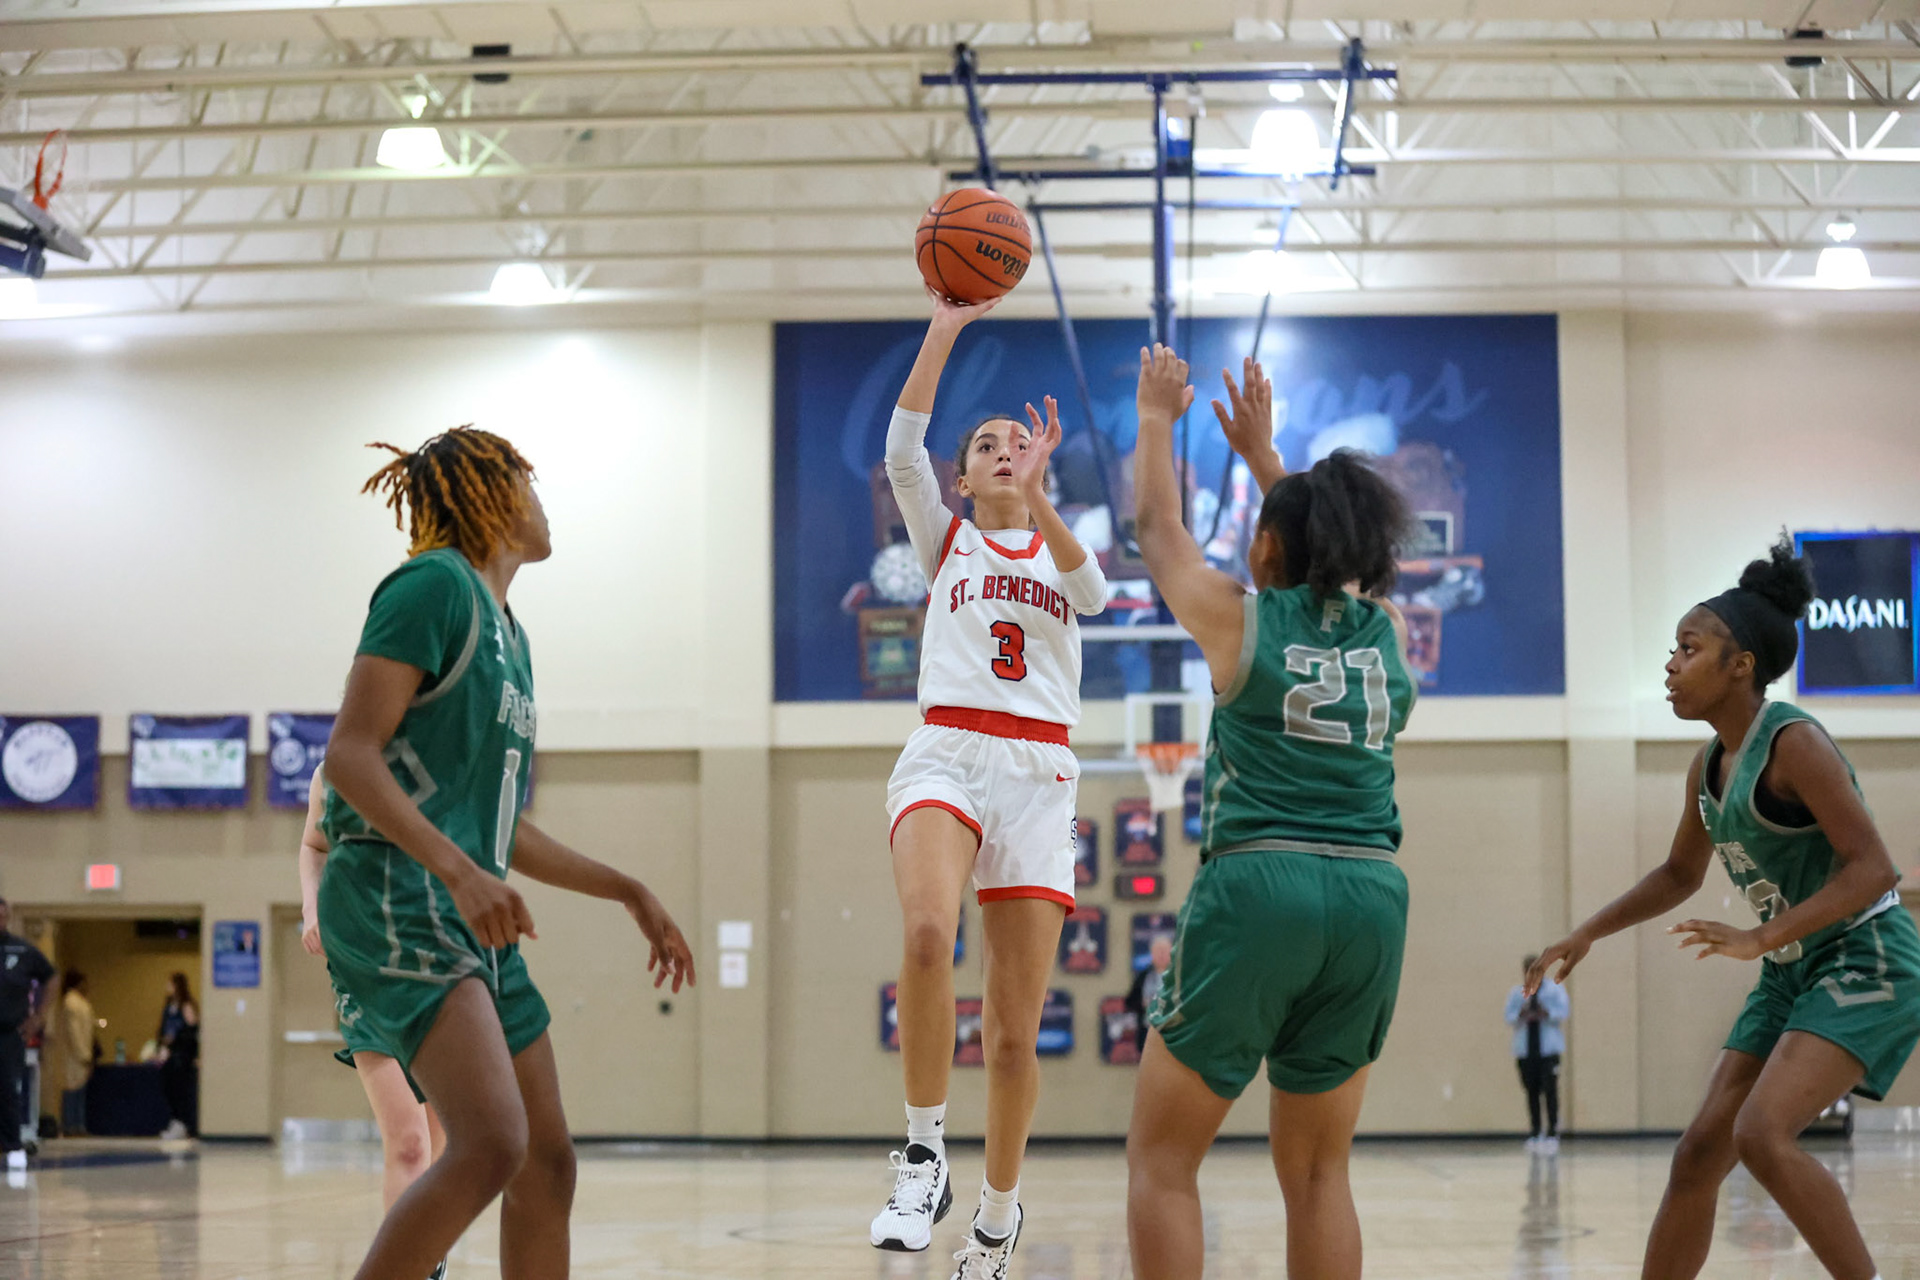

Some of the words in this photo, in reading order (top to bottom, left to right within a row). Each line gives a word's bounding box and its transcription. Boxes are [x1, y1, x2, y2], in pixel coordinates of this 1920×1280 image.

[950, 578, 974, 613] ST.
[982, 575, 1070, 626] BENEDICT
[1808, 594, 1906, 633] DASANI
[990, 620, 1027, 682] 3
[1284, 644, 1391, 750] 21
